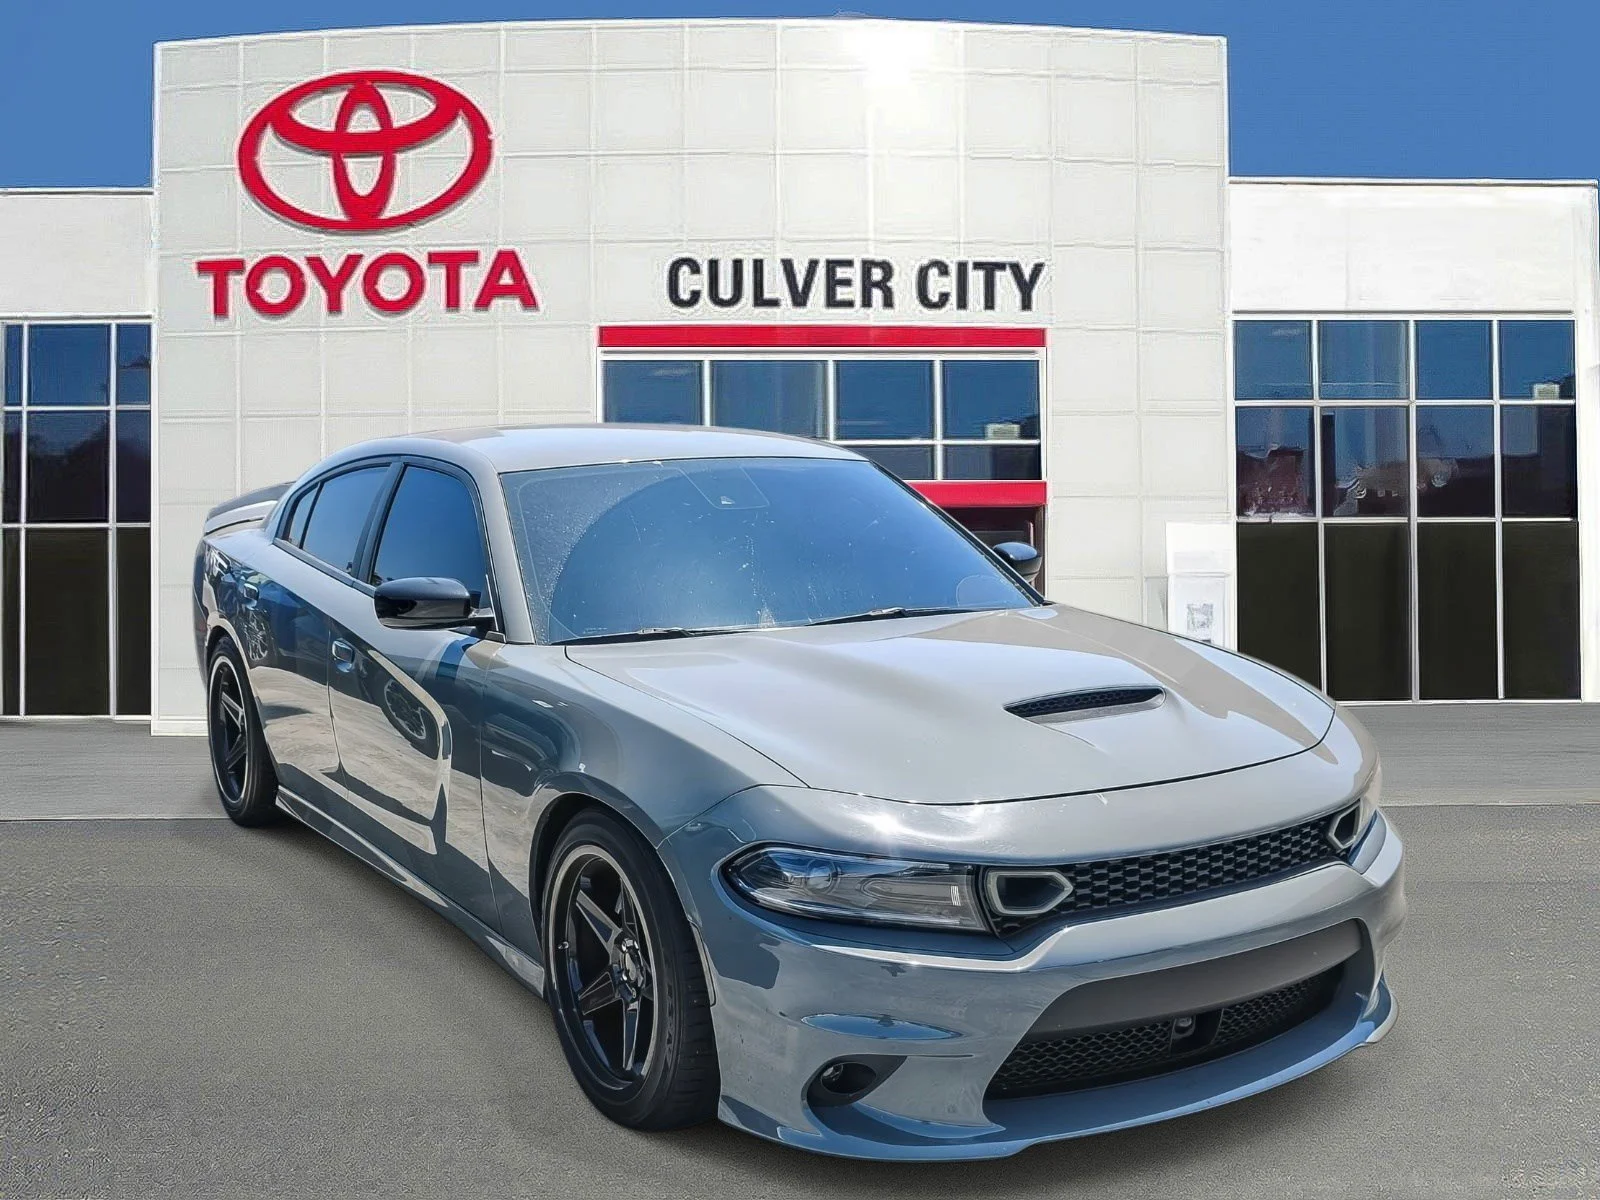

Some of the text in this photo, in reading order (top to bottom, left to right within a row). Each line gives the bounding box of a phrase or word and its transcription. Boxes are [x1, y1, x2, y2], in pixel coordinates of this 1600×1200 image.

[196, 249, 539, 319] TOYOTA
[668, 257, 1045, 311] CULVER CITY
